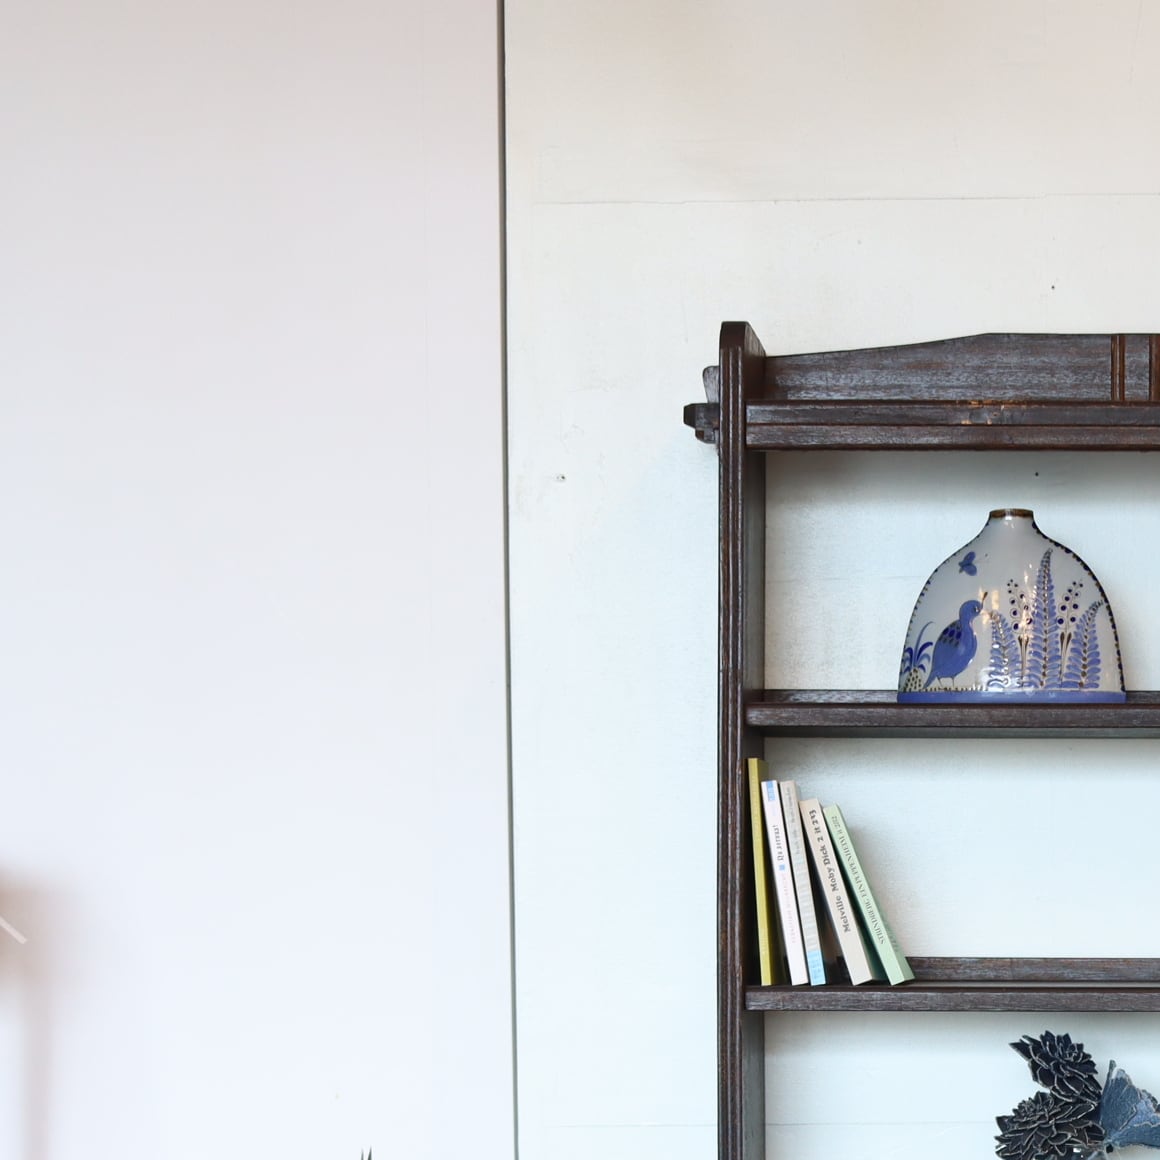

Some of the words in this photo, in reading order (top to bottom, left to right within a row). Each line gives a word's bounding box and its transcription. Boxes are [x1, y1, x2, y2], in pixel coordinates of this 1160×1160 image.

[819, 845, 831, 865] Dick
[827, 867, 839, 892] Moby
[836, 895, 851, 933] Melville
[863, 899, 884, 945] STRINDBERG
